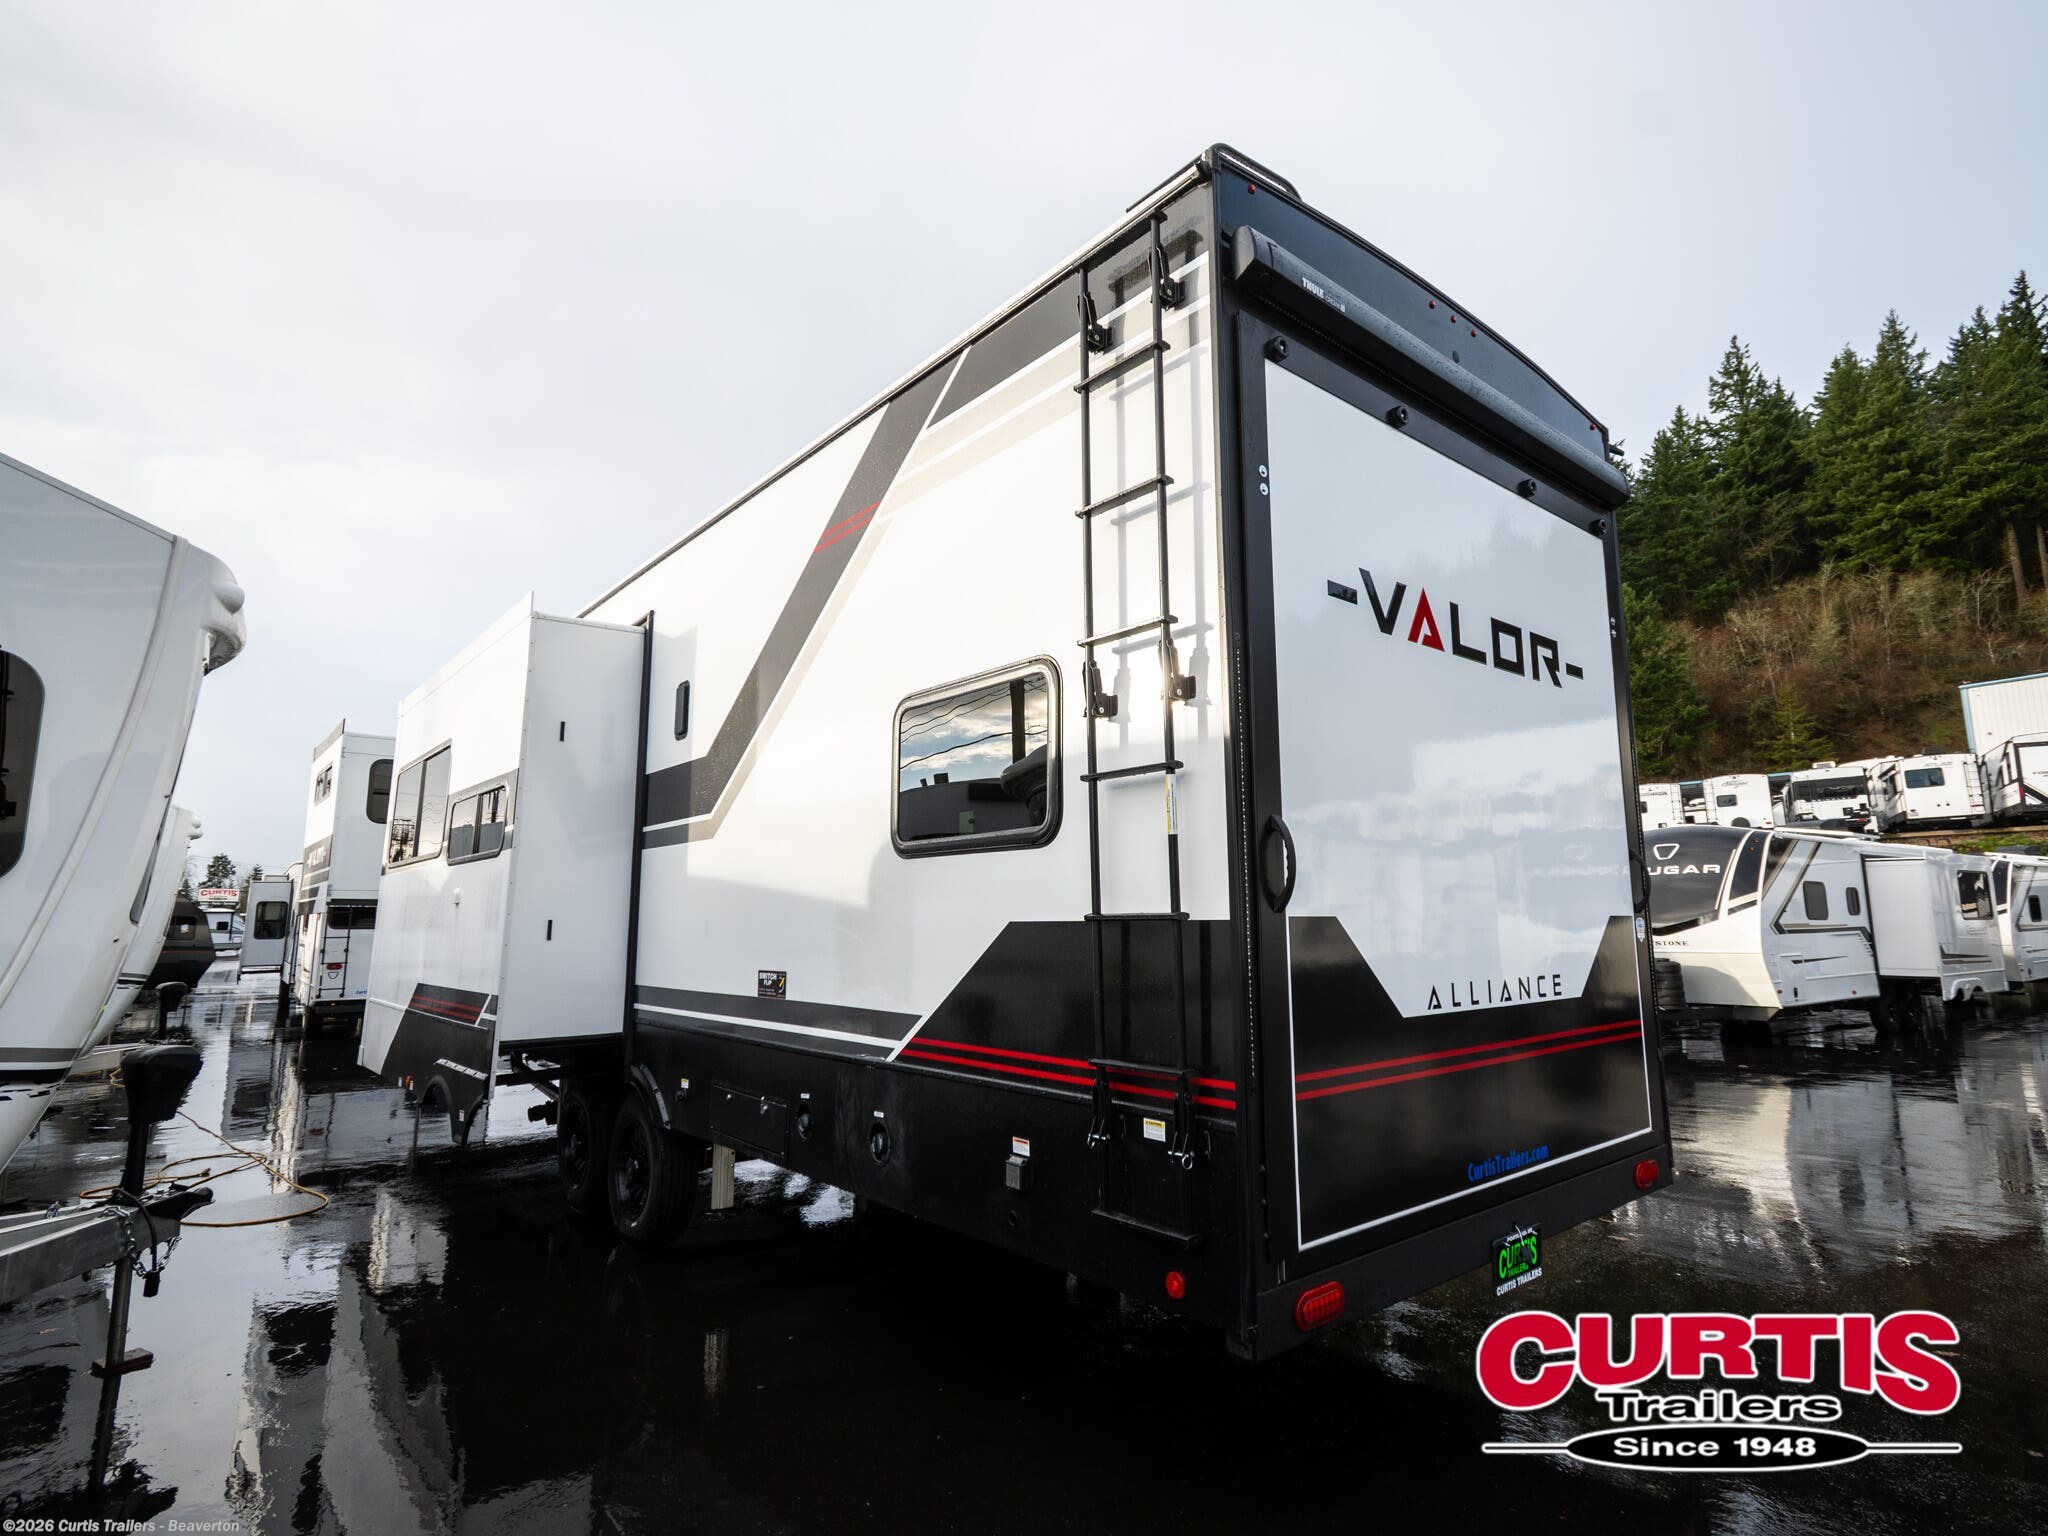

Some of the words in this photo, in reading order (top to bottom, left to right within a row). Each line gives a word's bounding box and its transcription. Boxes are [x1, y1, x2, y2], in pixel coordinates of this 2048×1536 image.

[1647, 864, 1721, 876] UGAR
[200, 889, 238, 897] CURTIS
[1427, 974, 1562, 1010] ALLIANCE
[1467, 1145, 1549, 1182] CurtisTrailers.com
[1499, 1235, 1538, 1279] CURS
[1496, 1279, 1517, 1297] CURTIS
[1517, 1267, 1543, 1286] TRAILERS
